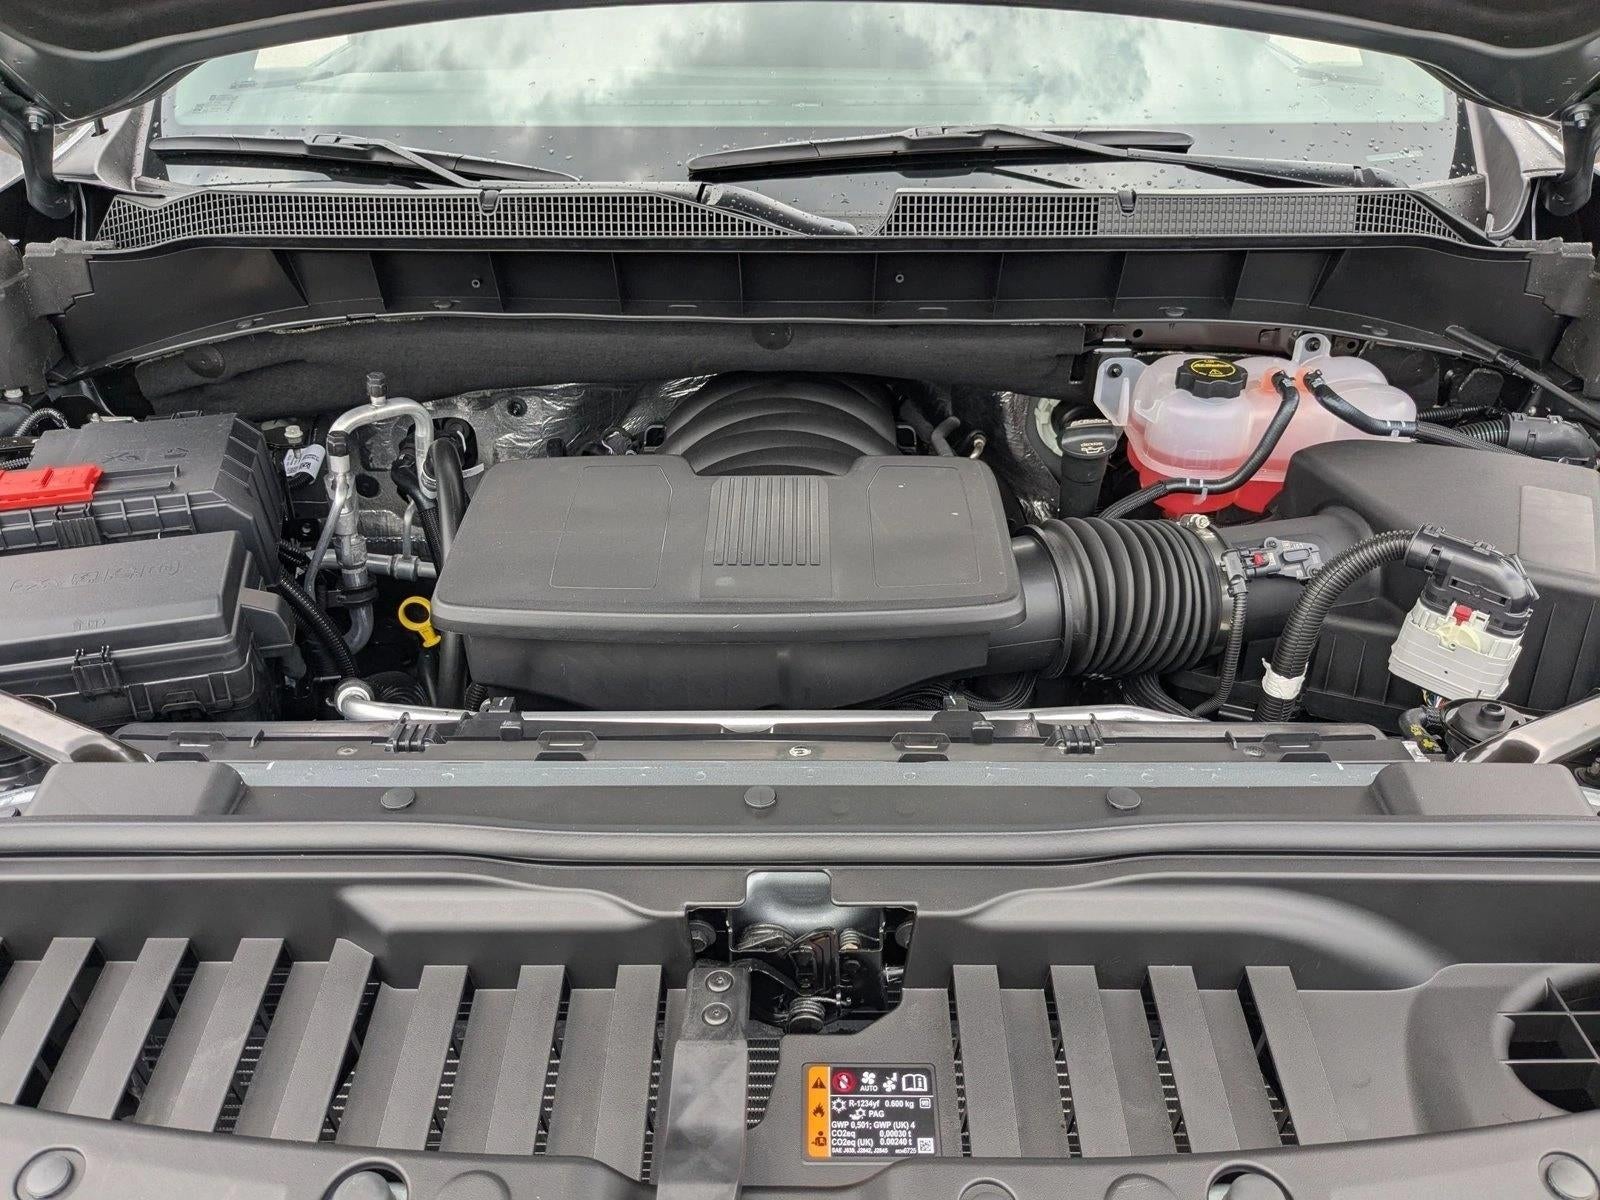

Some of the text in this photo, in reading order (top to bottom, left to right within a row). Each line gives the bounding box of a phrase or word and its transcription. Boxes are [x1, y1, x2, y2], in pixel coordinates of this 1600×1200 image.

[1070, 418, 1109, 426] ACDelco
[849, 1099, 915, 1109] R-1234yf 0.600 kg
[893, 1121, 909, 1130] (UK)
[831, 1130, 856, 1138] CO2eq
[831, 1138, 874, 1147] CO2eq (UK)
[880, 1138, 913, 1146] 0.00240 t
